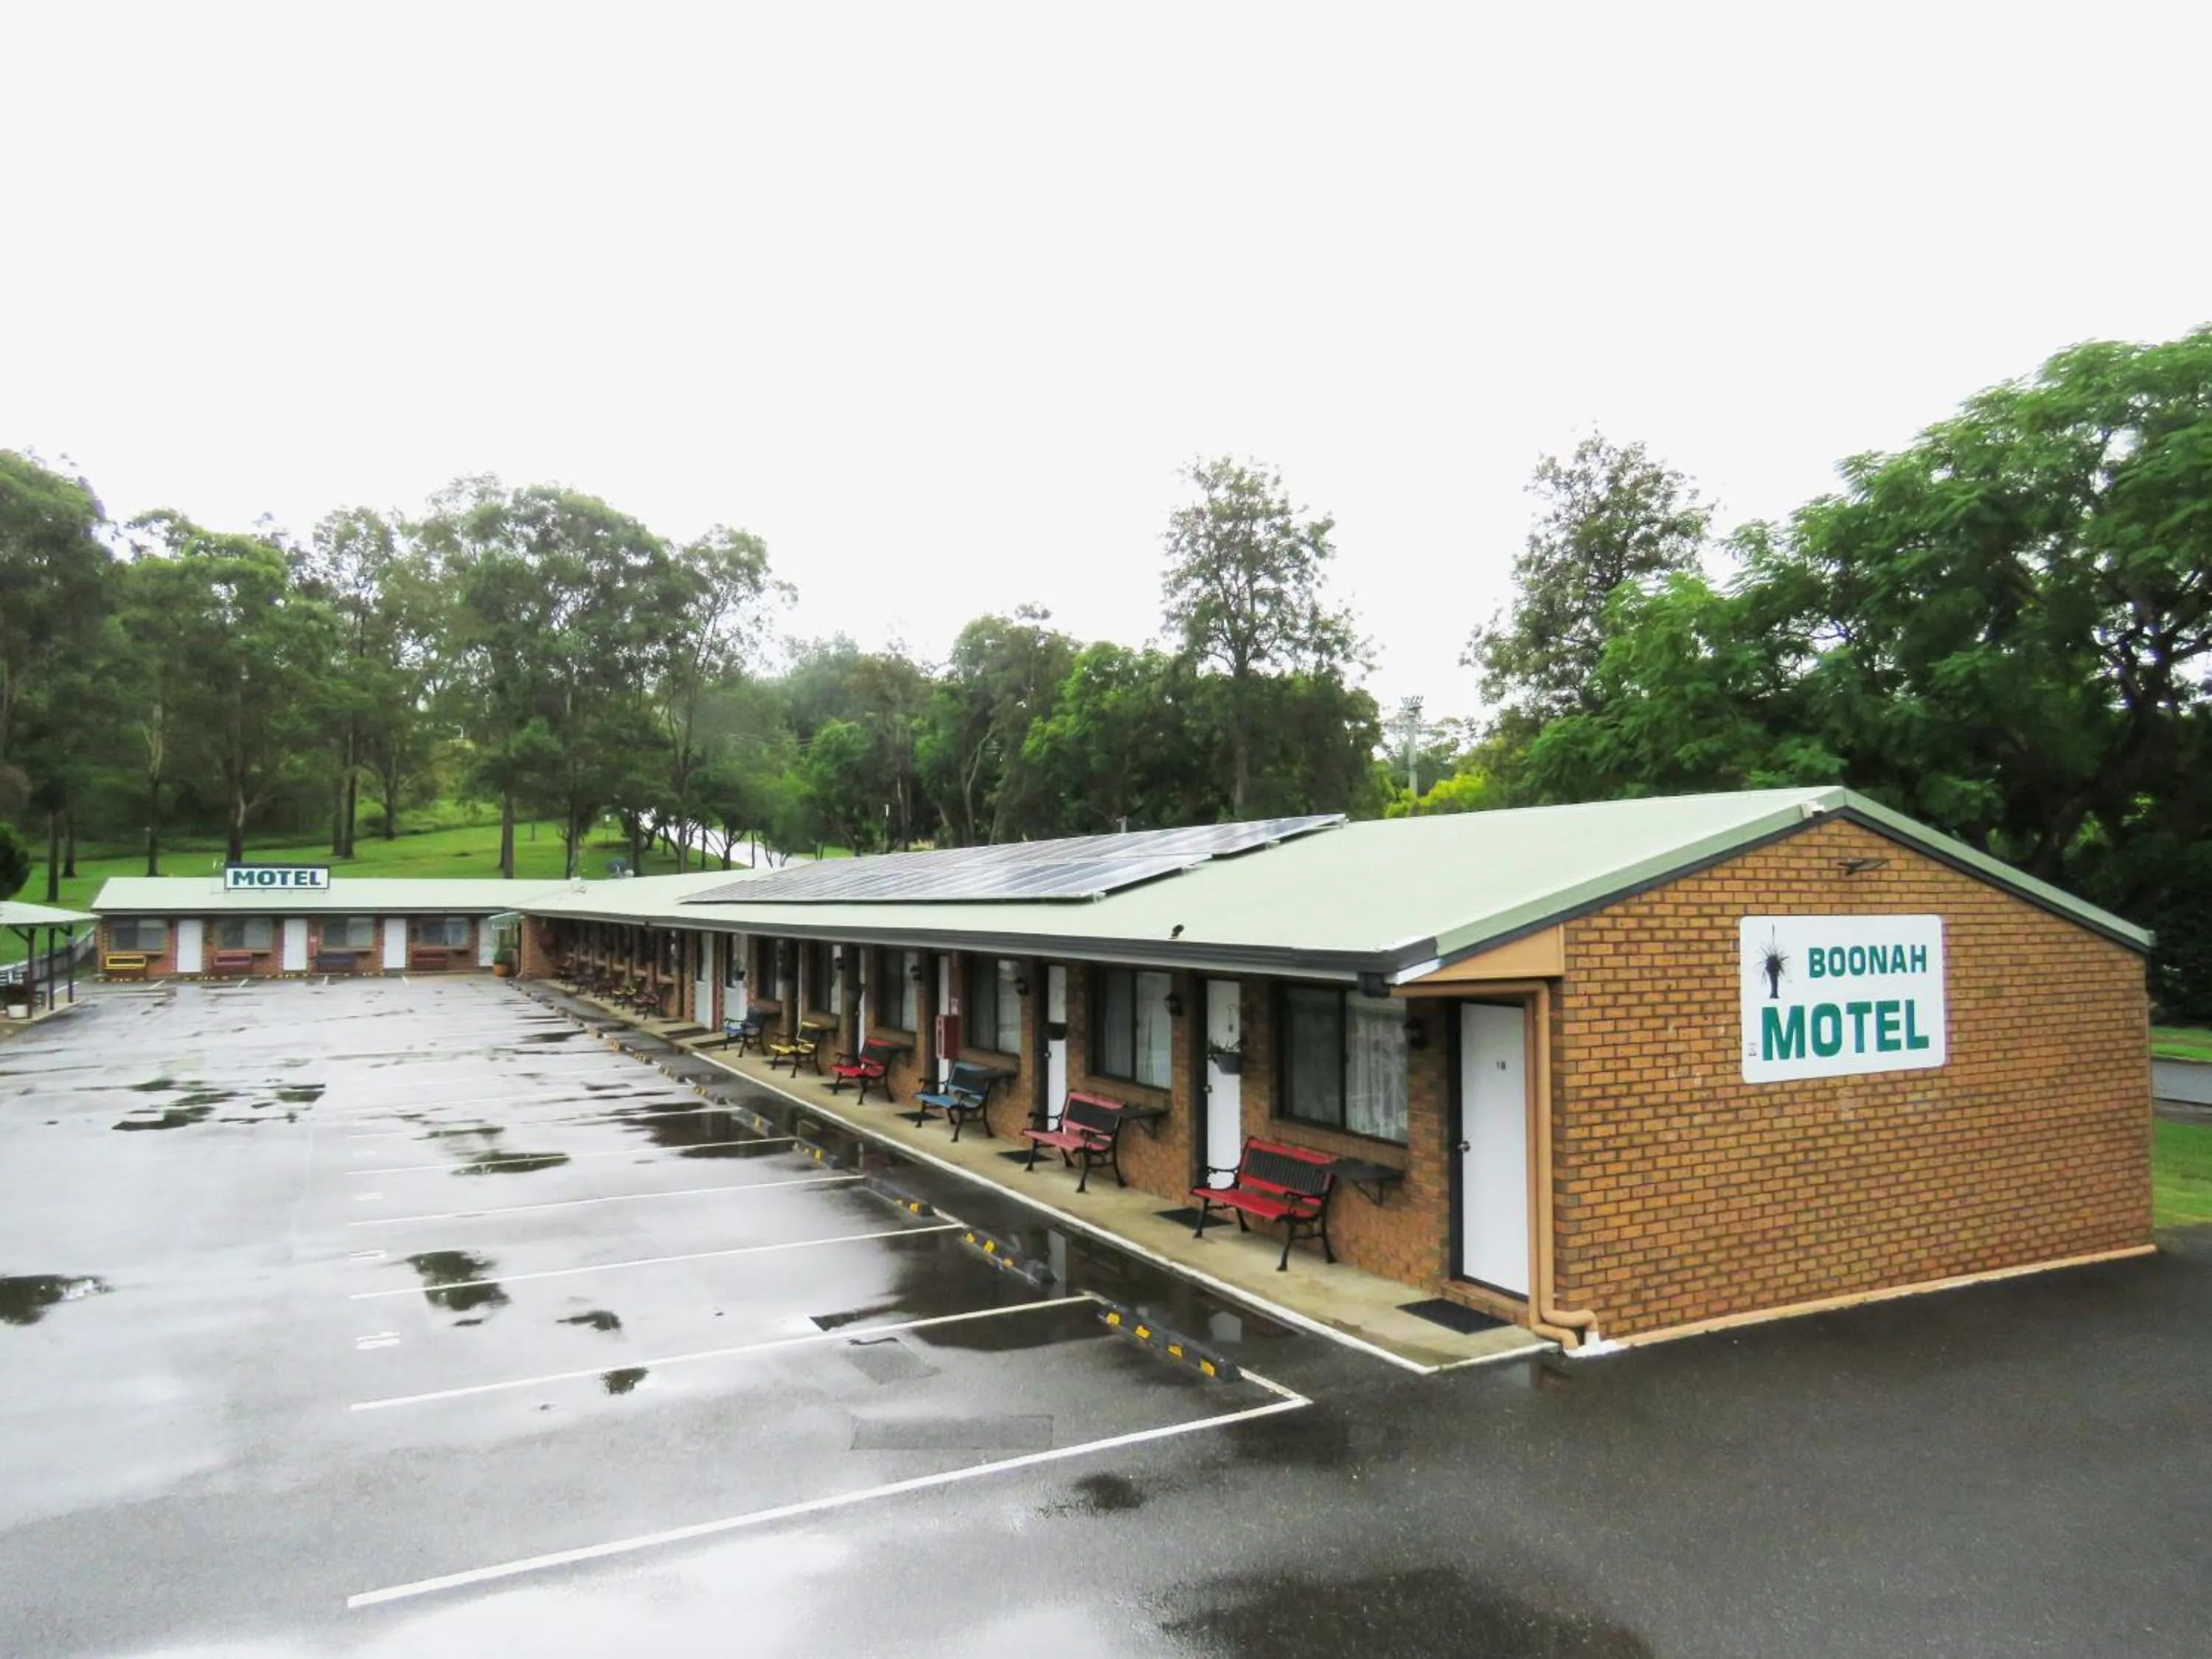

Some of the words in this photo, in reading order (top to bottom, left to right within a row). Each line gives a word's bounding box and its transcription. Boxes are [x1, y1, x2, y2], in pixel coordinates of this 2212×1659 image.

[232, 870, 321, 886] MOTEL
[1808, 944, 1927, 978] BOONAH
[1761, 999, 1930, 1061] MOTEL
